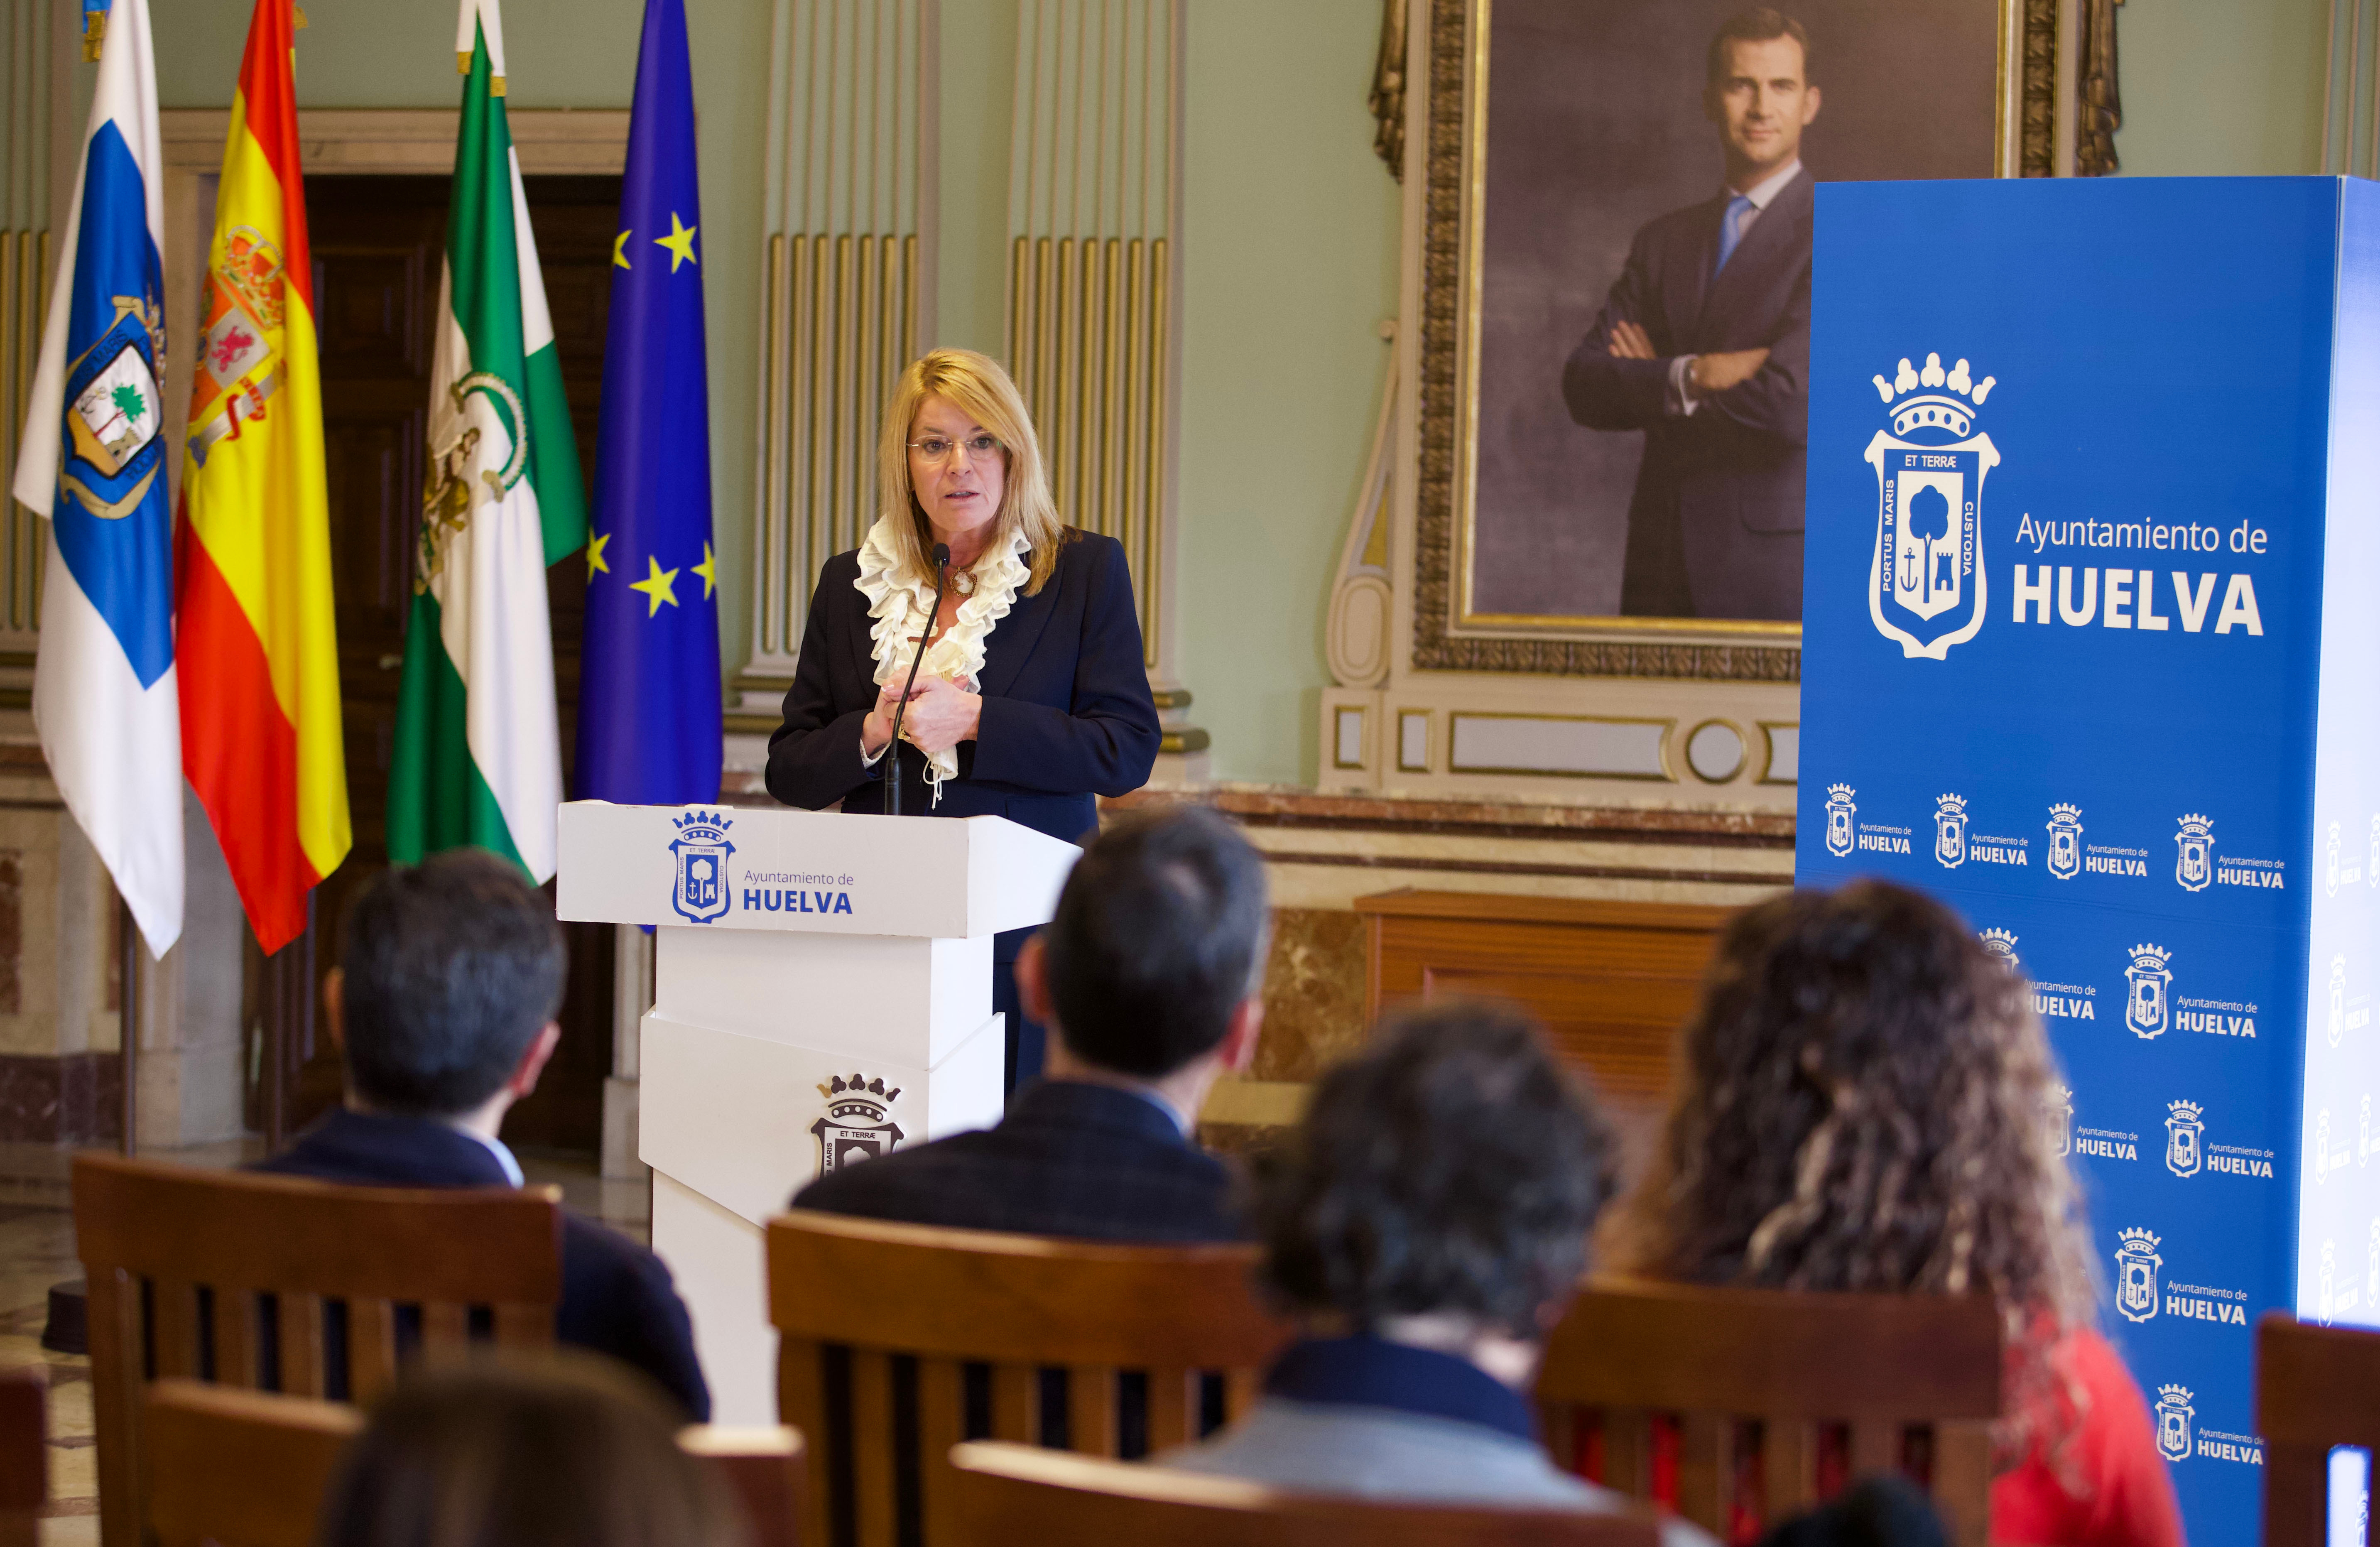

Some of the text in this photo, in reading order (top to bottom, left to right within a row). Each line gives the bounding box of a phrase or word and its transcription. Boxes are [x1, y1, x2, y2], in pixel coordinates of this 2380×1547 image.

[1905, 454, 1918, 467] ET
[1882, 479, 1895, 591] PORTUS MARIS
[1963, 501, 1974, 576] CUSTODIA
[2015, 512, 2267, 554] Ayuntamiento de
[2013, 564, 2263, 636] HUELVA
[1860, 822, 1911, 835] Ayuntamiento de
[1859, 834, 1911, 854] HUELVA
[1971, 834, 2028, 846] Ayuntamiento de
[1971, 846, 2027, 865] HUELVA
[2086, 844, 2148, 857] Ayuntamiento de
[2086, 856, 2147, 876] HUELVA
[2218, 856, 2284, 868] Ayuntamiento de
[744, 870, 853, 885] Ayuntamiento de
[2218, 868, 2284, 889] HUELVA
[744, 889, 853, 914] HUELVA
[2085, 985, 2096, 995] de
[2177, 995, 2257, 1013] Ayuntamiento de
[2176, 1011, 2256, 1038] HUELVA
[2077, 1125, 2127, 1139] Ayuntamiento
[2129, 1132, 2138, 1141] de
[2076, 1138, 2137, 1160] HUELVA
[2208, 1142, 2274, 1158] Ayuntamiento de
[2207, 1155, 2273, 1178] HUELVA
[2167, 1280, 2247, 1301] Ayuntamiento de
[2166, 1295, 2246, 1325] HUELVA
[2199, 1427, 2264, 1445] Ayuntamiento de
[2198, 1440, 2263, 1465] HUELVA
